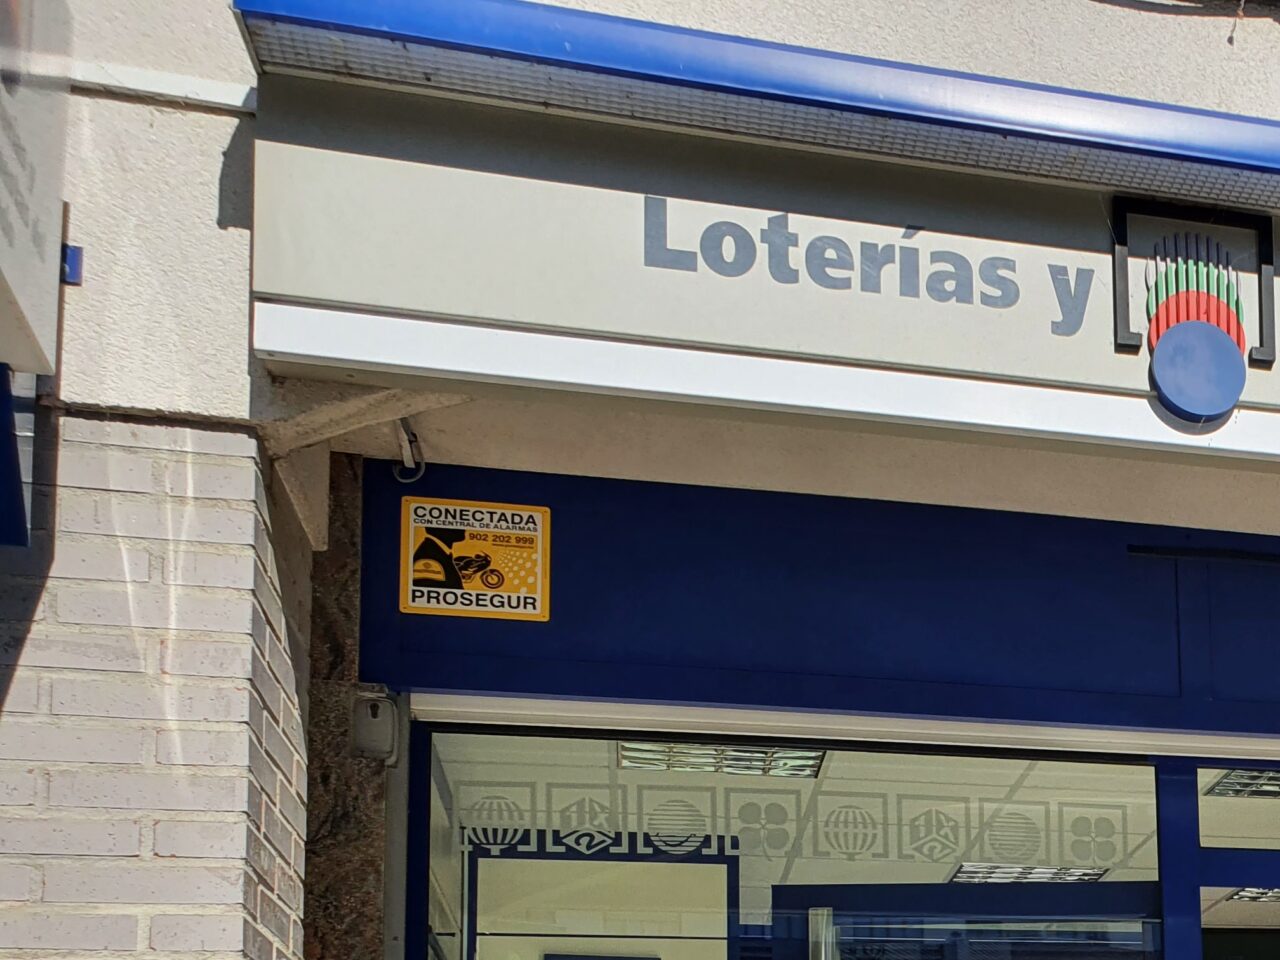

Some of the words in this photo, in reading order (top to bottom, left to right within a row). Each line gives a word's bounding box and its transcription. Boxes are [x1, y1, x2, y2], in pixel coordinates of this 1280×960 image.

[643, 195, 1021, 309] Loterías
[1048, 263, 1095, 337] y
[413, 506, 537, 526] CONECTADA
[436, 519, 476, 528] CENTRAL
[493, 523, 538, 532] ALARMAS
[469, 533, 489, 542] 902
[492, 534, 511, 543] 202
[412, 590, 537, 610] PROSEGUR
